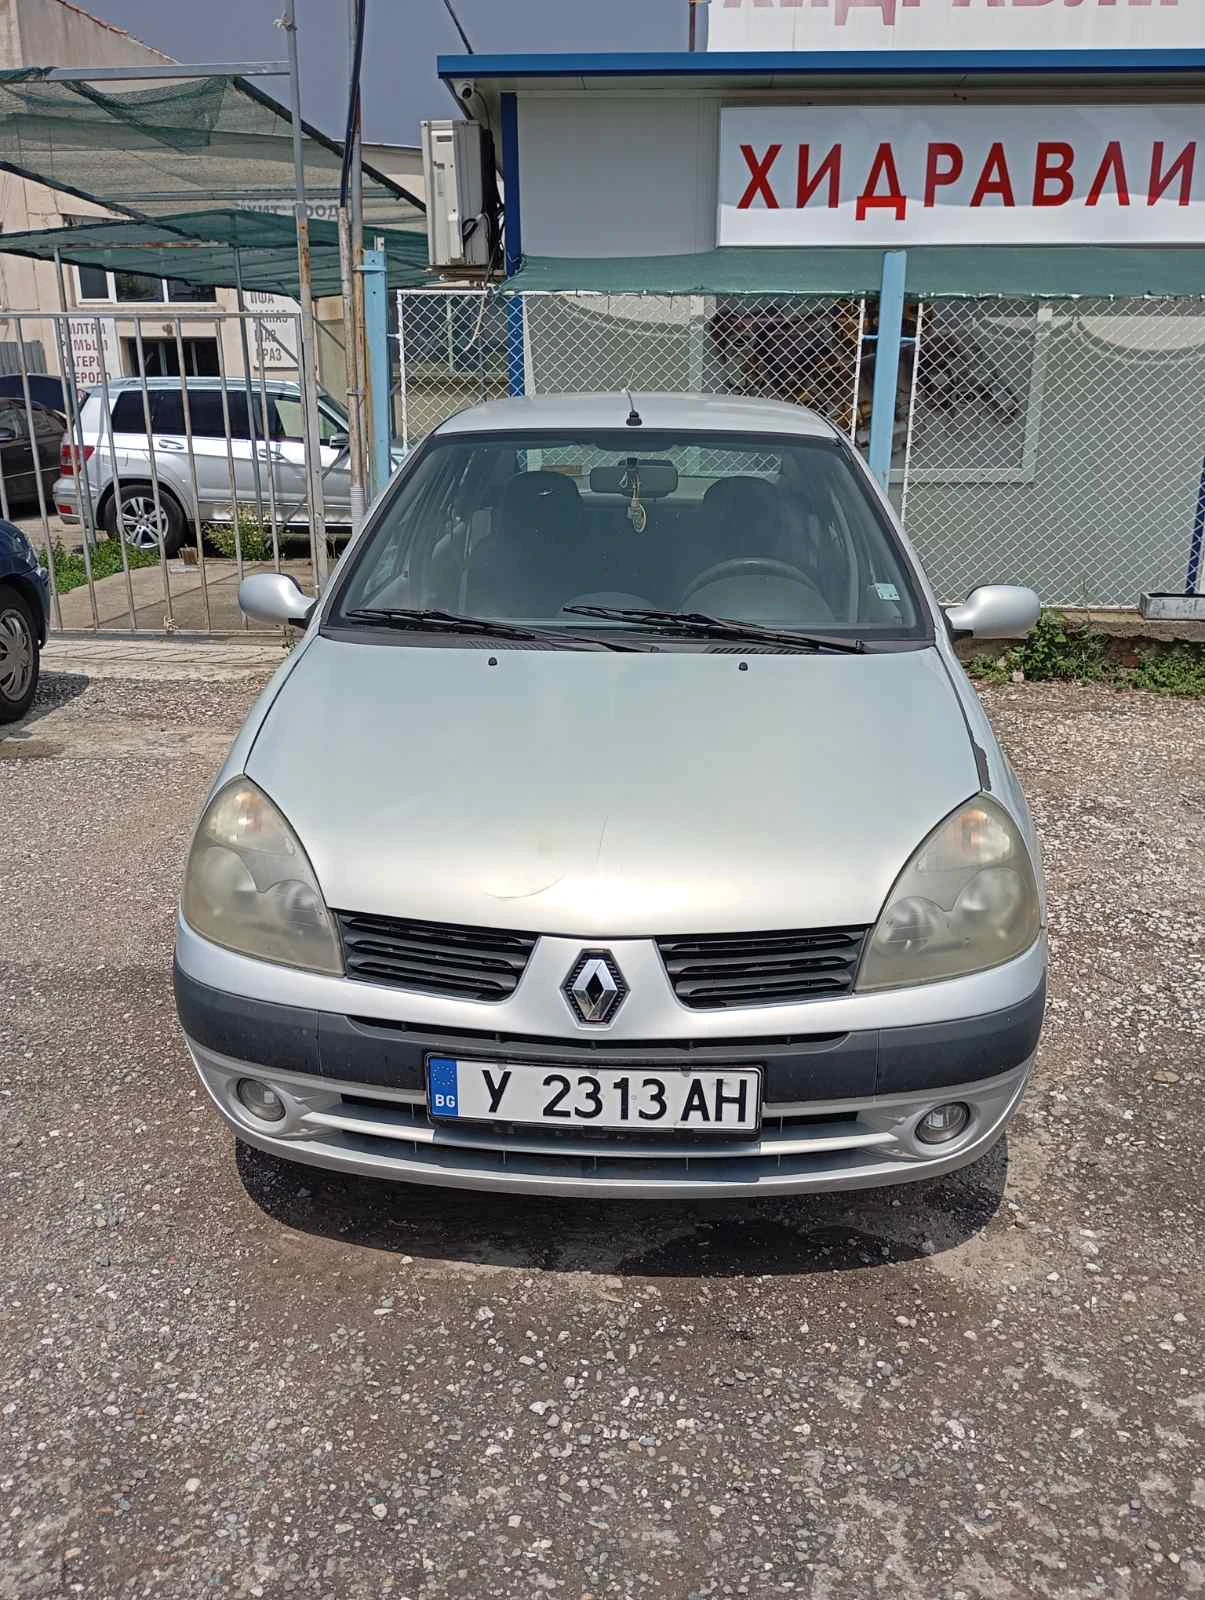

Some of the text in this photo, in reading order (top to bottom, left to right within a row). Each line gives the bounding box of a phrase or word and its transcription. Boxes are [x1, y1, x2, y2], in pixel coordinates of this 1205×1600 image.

[736, 141, 1197, 221] ХИДРАВЛИ
[256, 347, 282, 361] РАЗ
[435, 1094, 456, 1108] BG
[542, 1075, 668, 1121] 2313
